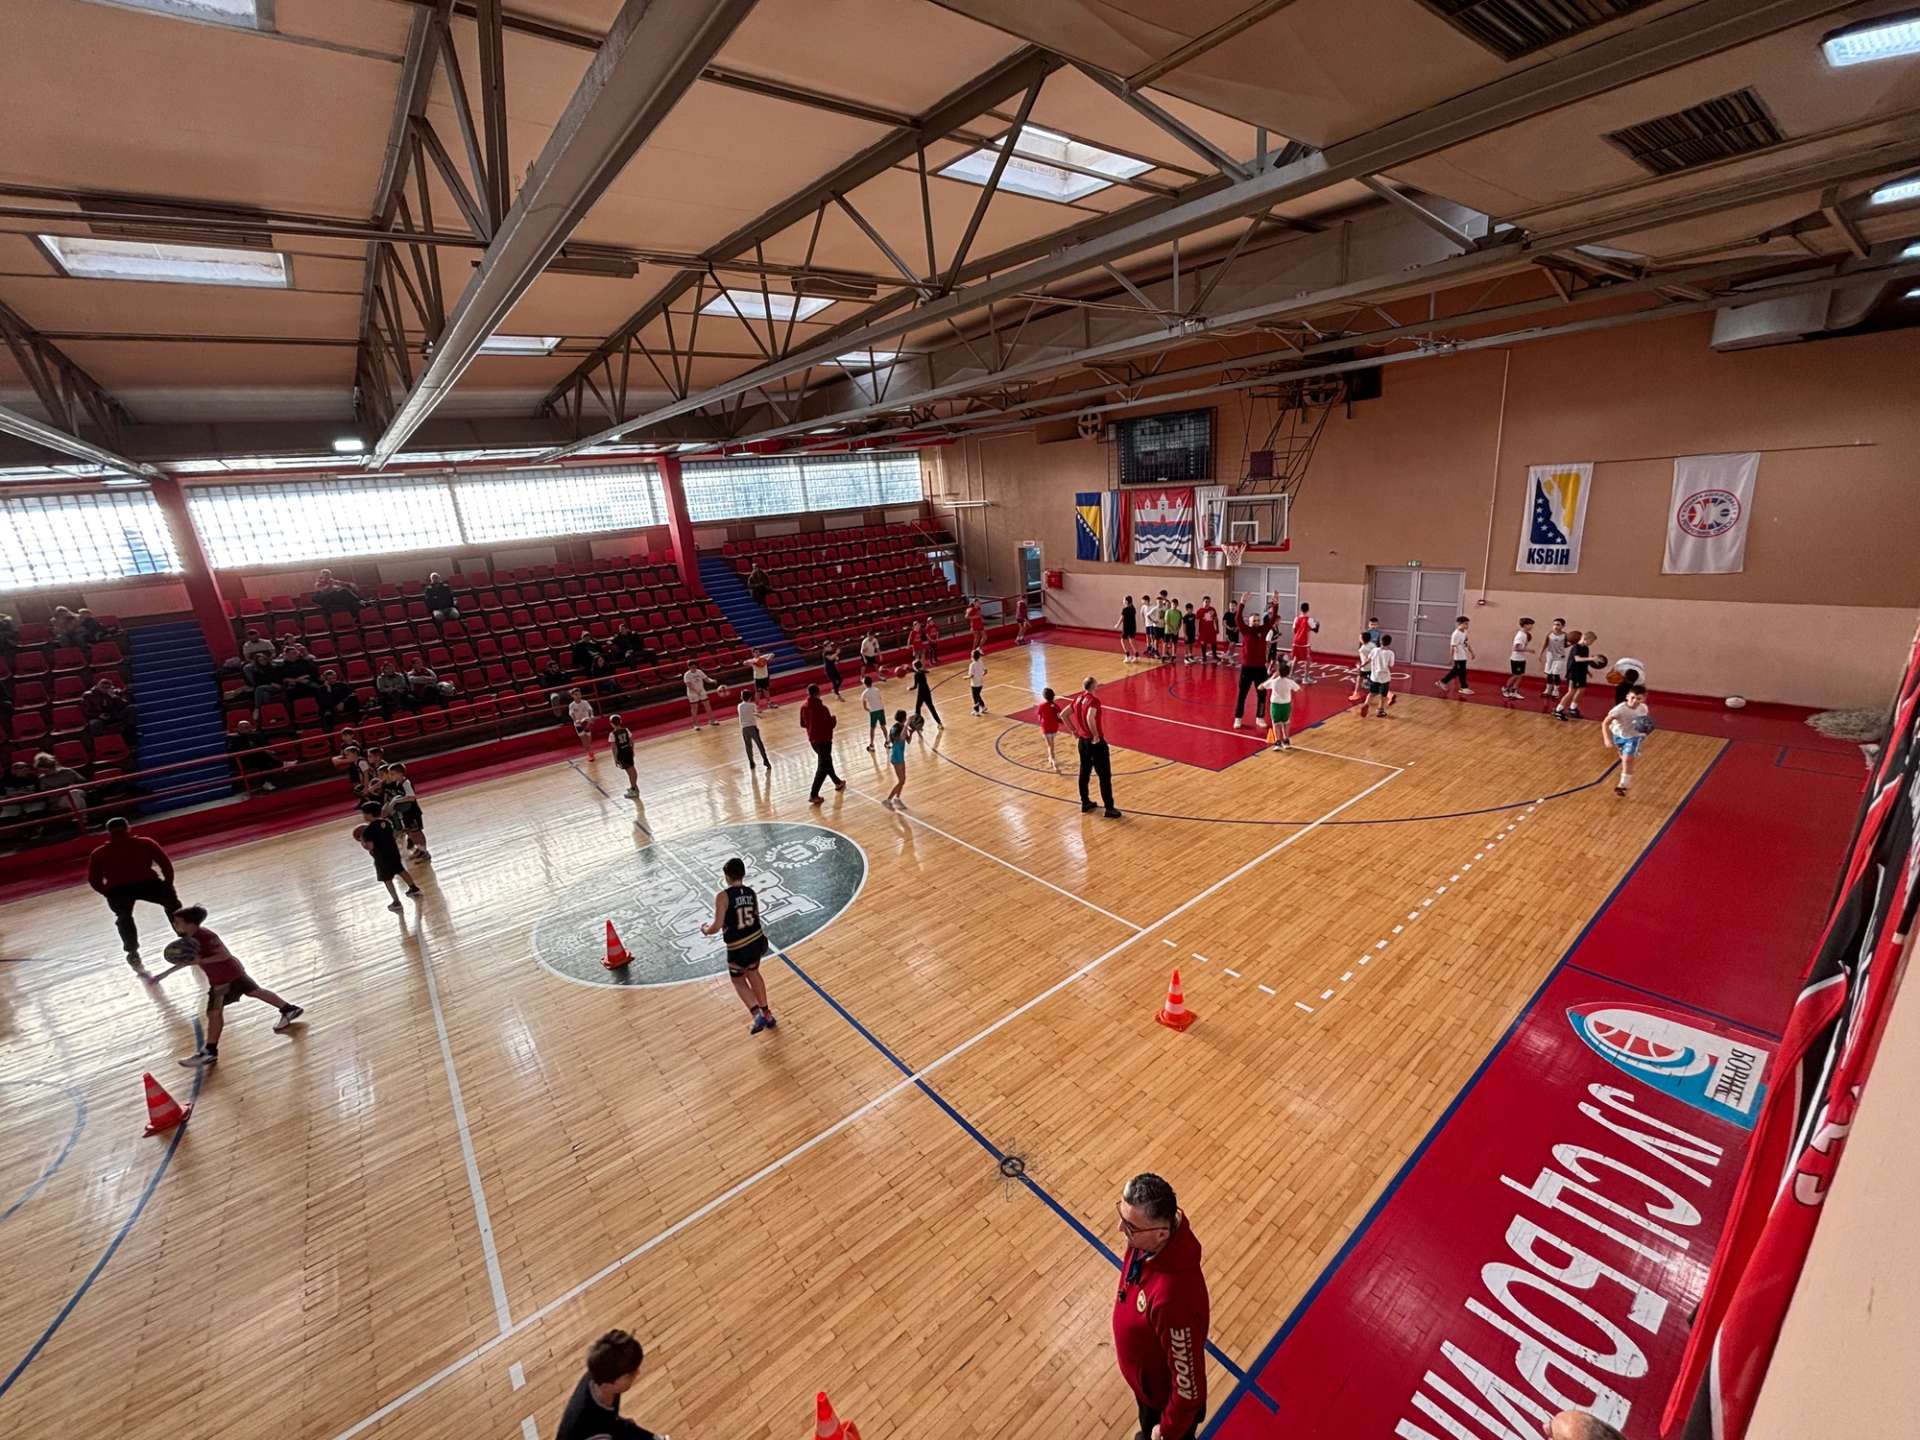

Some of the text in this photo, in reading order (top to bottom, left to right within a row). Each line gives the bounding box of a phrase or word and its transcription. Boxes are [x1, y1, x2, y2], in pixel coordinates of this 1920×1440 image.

[1526, 547, 1570, 566] KSBIH
[736, 905, 756, 930] 15
[1169, 1327, 1192, 1400] ROOKIE
